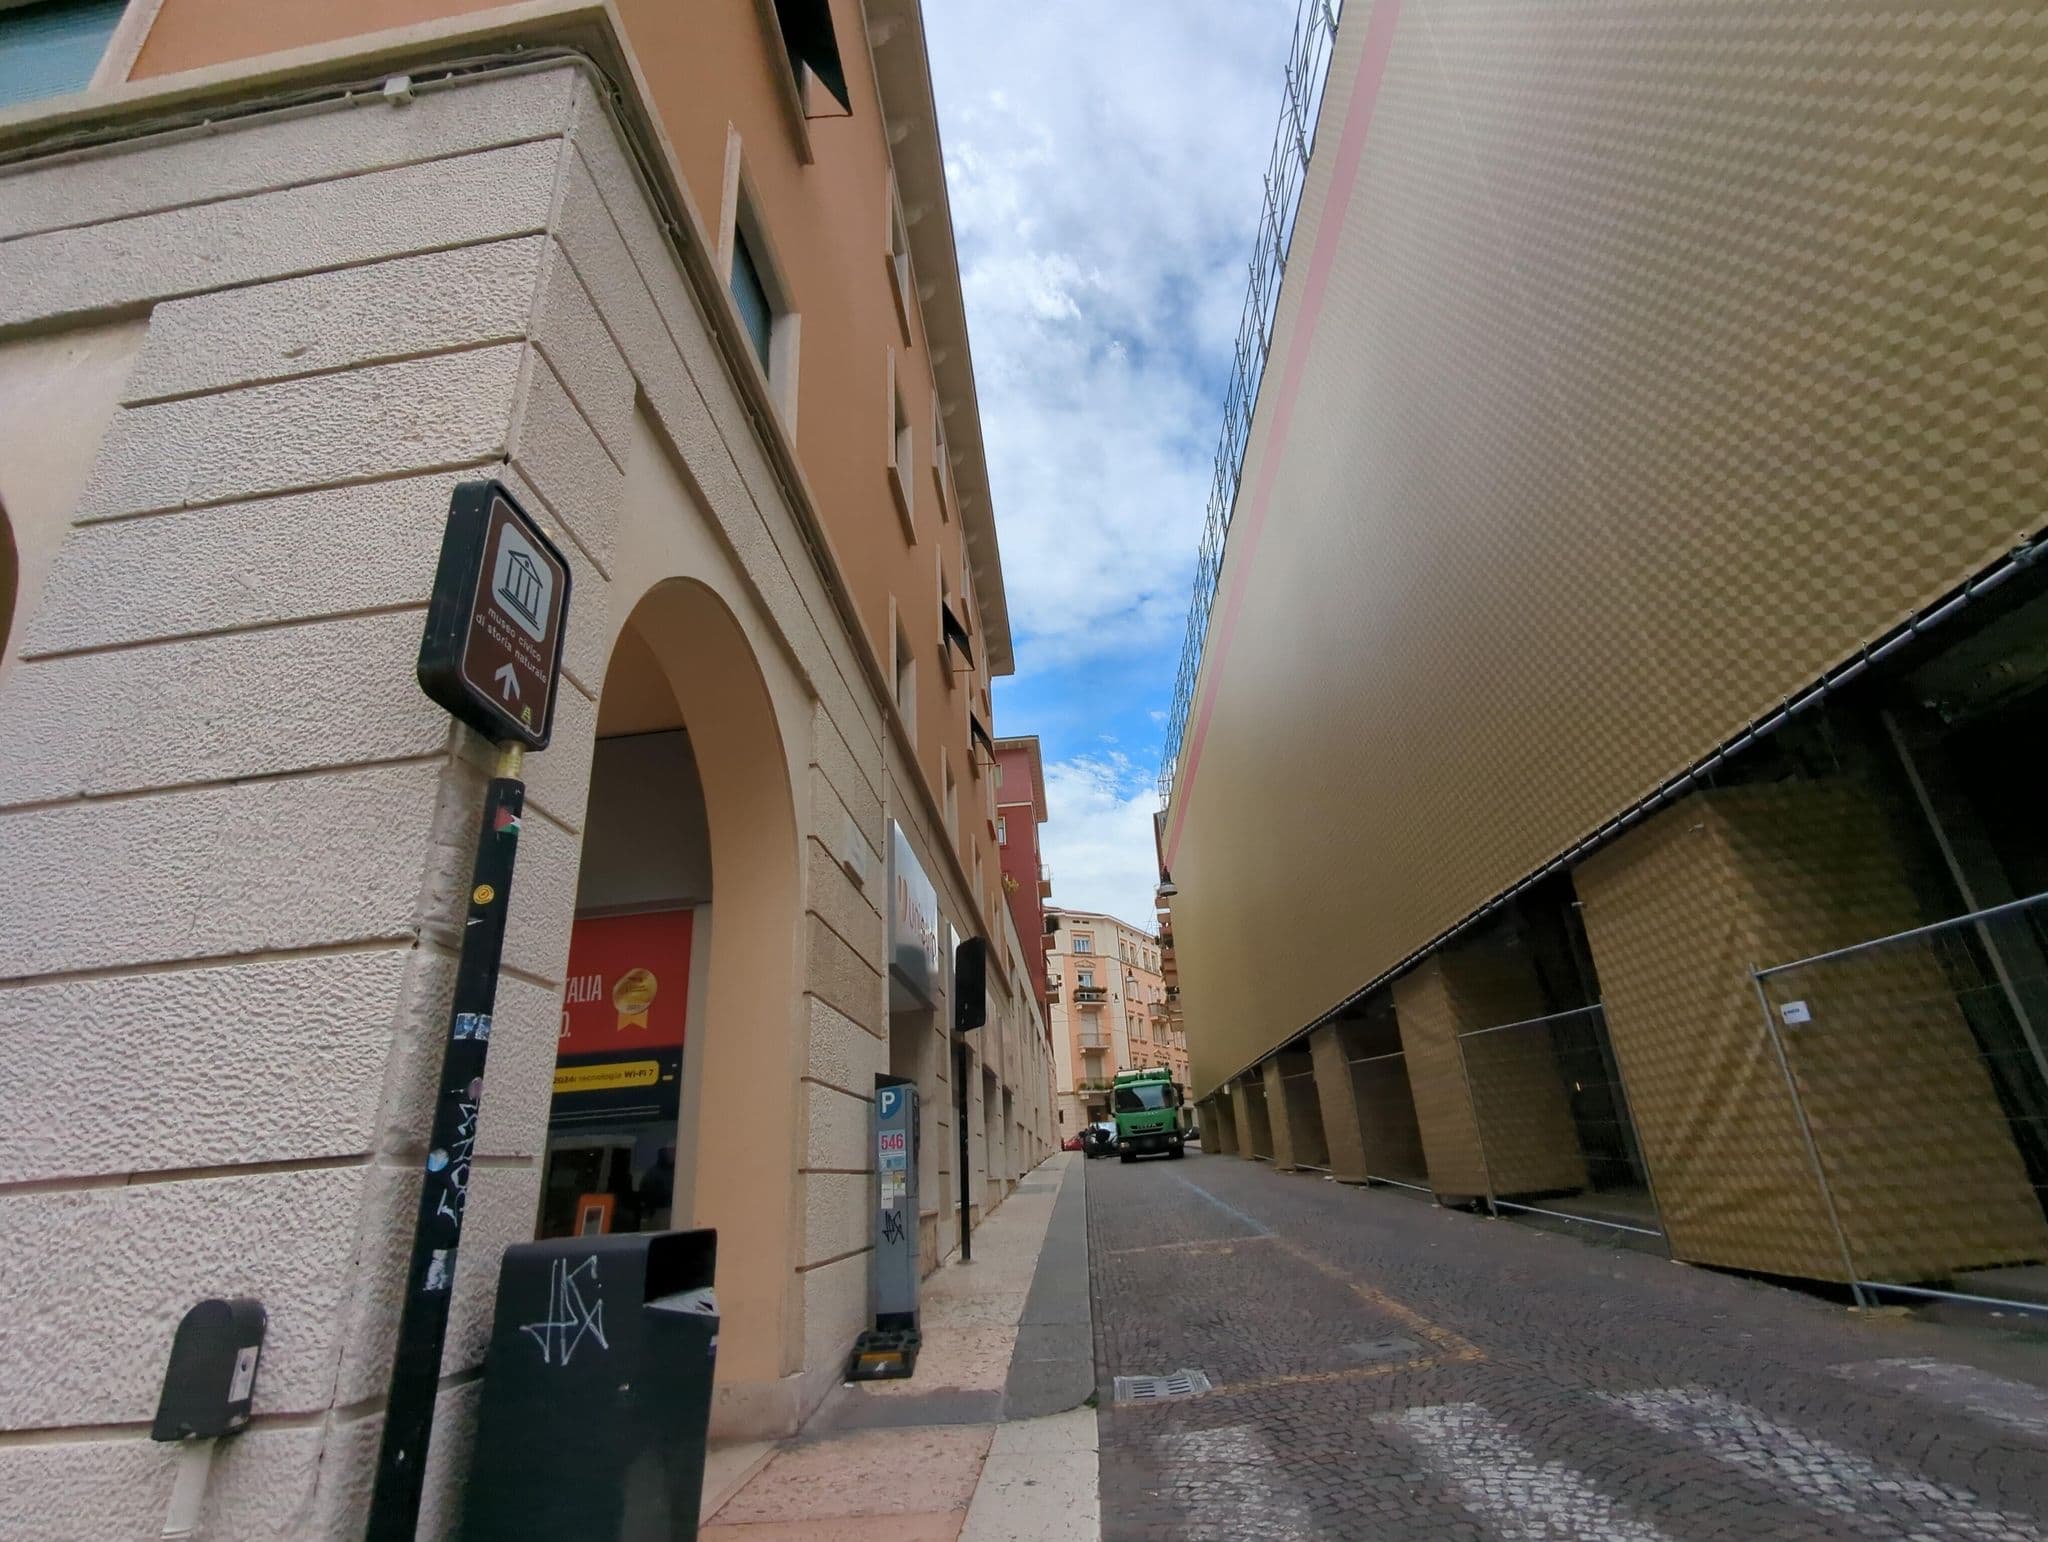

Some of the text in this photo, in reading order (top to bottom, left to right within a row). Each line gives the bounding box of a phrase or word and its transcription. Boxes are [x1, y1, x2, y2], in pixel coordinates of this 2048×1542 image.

[476, 614, 547, 683] di storia naturale
[488, 608, 542, 662] museo civico
[881, 1091, 896, 1114] P
[881, 1133, 904, 1150] 546
